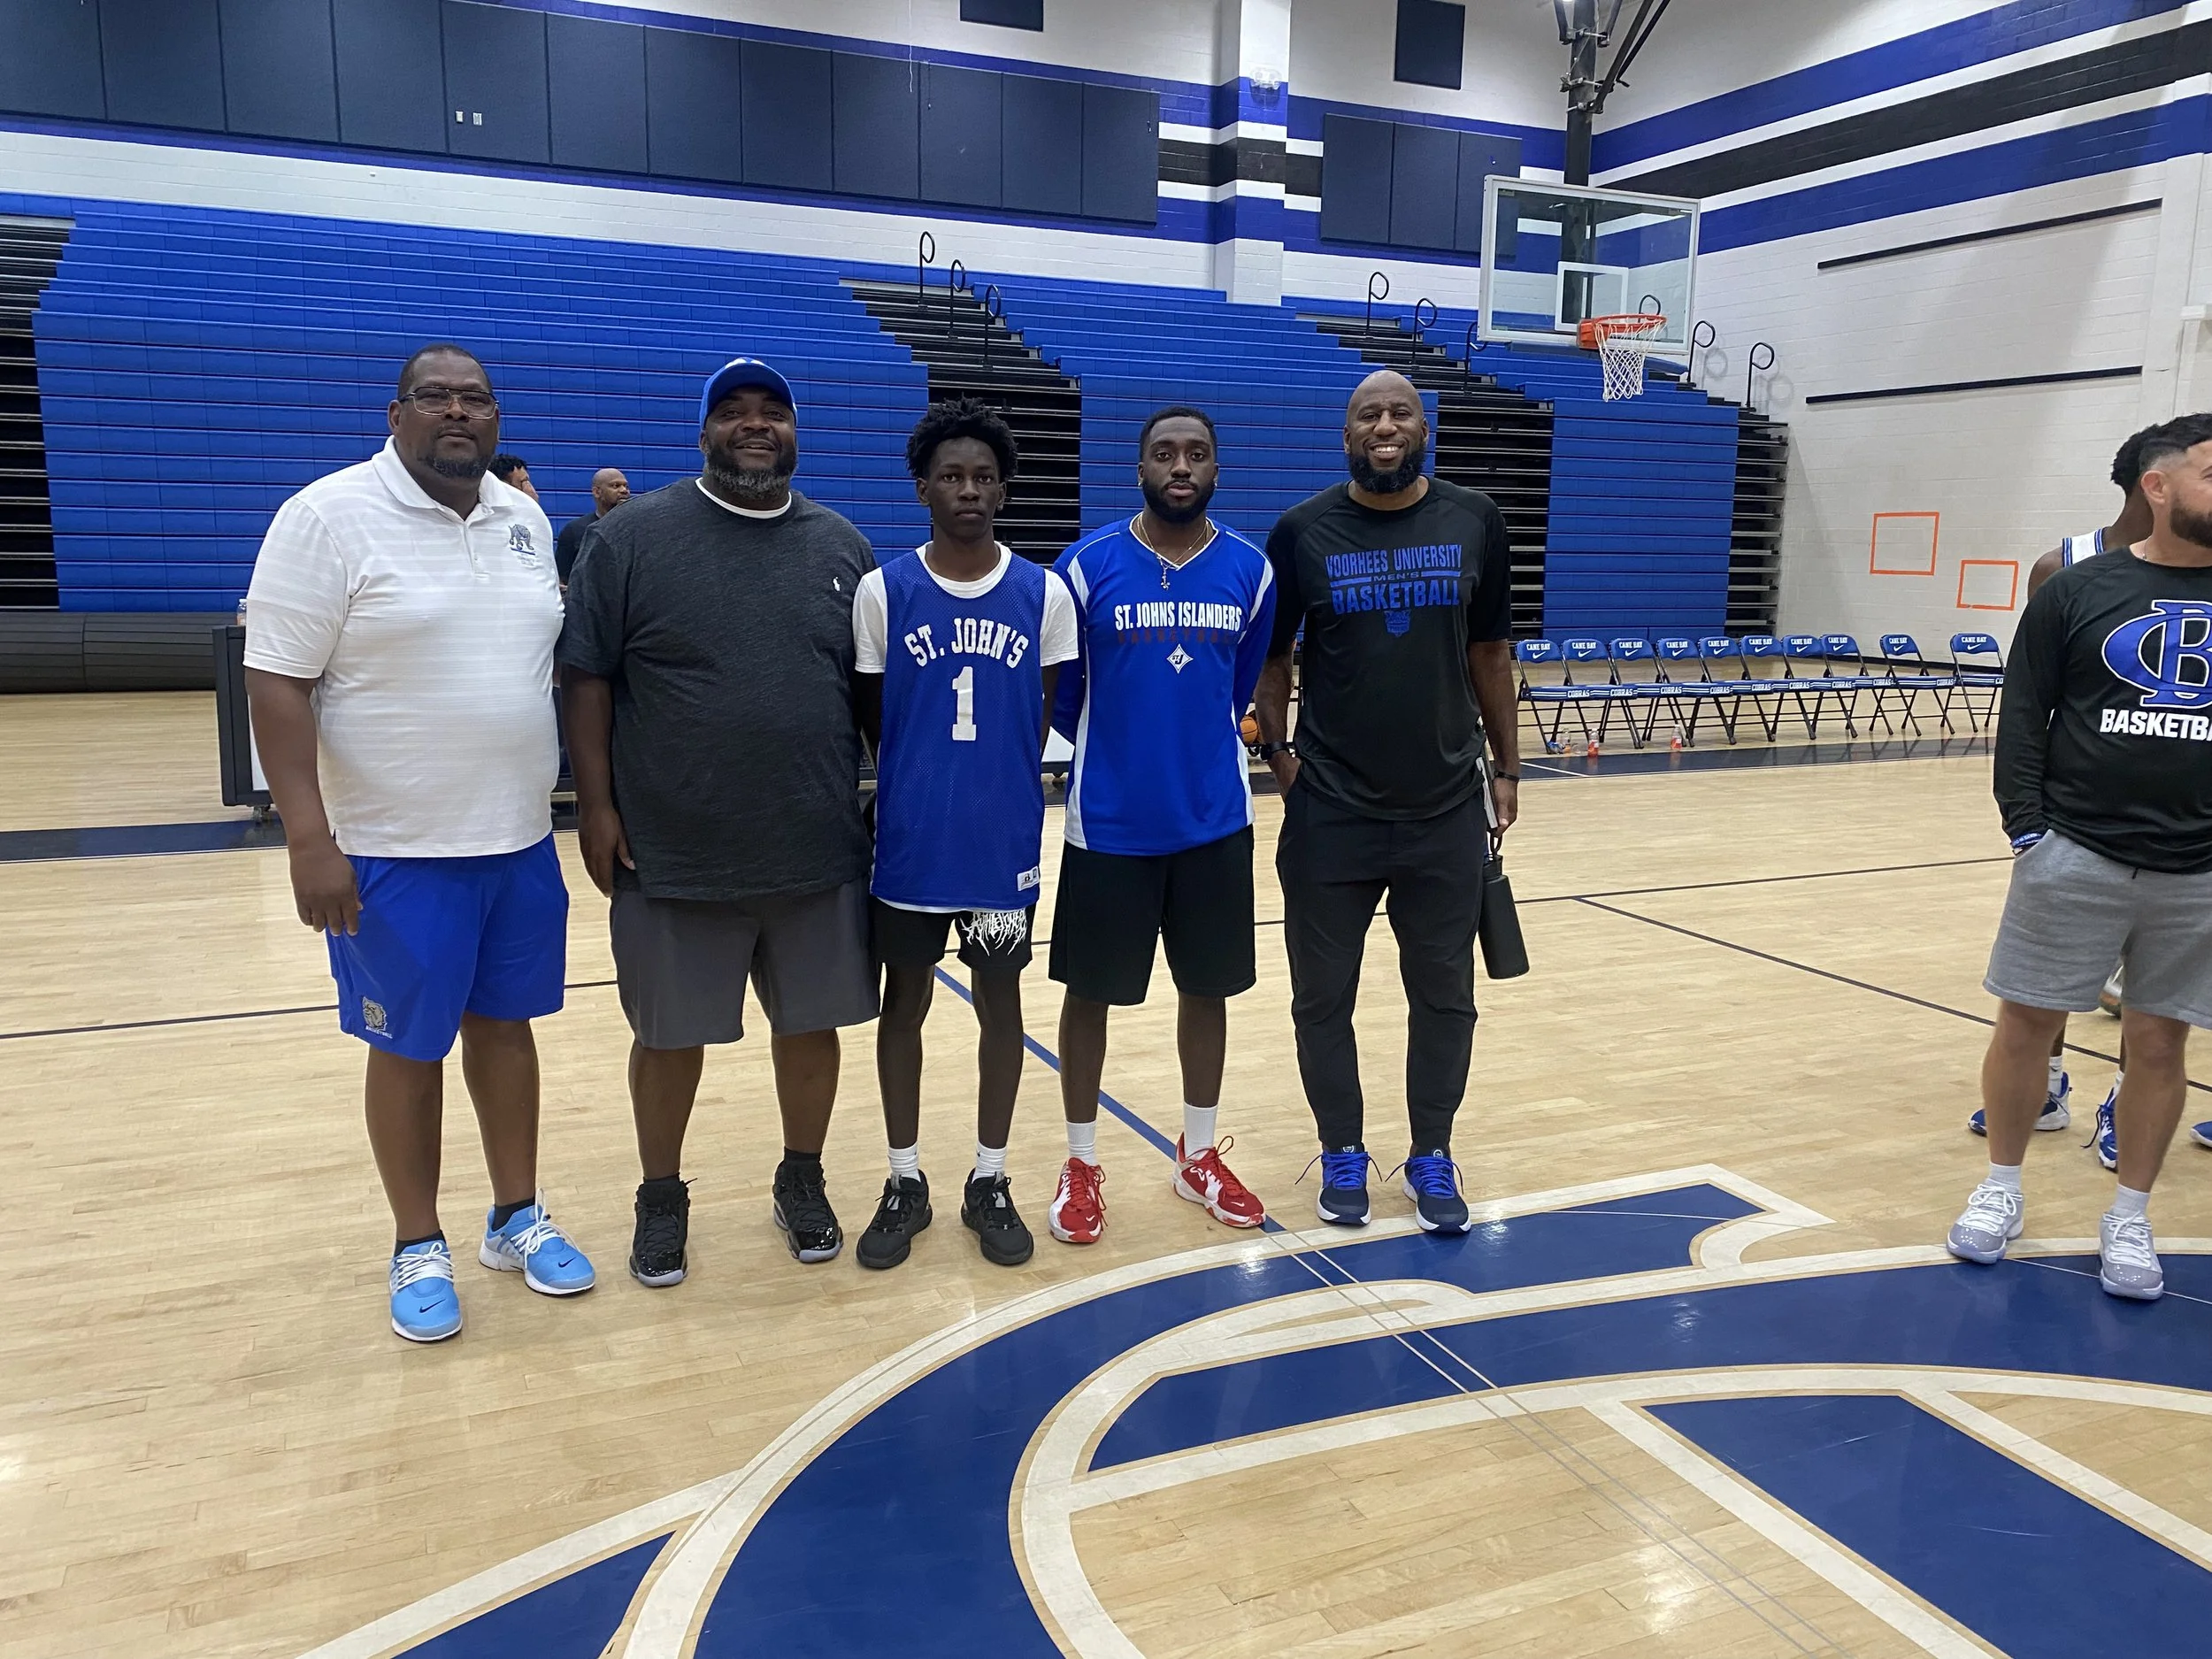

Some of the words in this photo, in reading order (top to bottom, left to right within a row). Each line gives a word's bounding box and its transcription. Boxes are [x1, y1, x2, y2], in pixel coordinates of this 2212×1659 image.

[1325, 550, 1388, 578] VOORHEES
[1394, 544, 1462, 570] UNIVERSITY
[1373, 572, 1419, 581] MEN'S
[1331, 580, 1460, 615] BASKETBALL
[1115, 604, 1134, 631] ST.
[1136, 602, 1176, 628] JOHNS
[1178, 602, 1243, 632] ISLANDERS
[904, 625, 946, 667] ST.
[951, 618, 1029, 669] JOHN'S
[952, 666, 977, 741] 1
[2100, 709, 2212, 741] BASKETB
